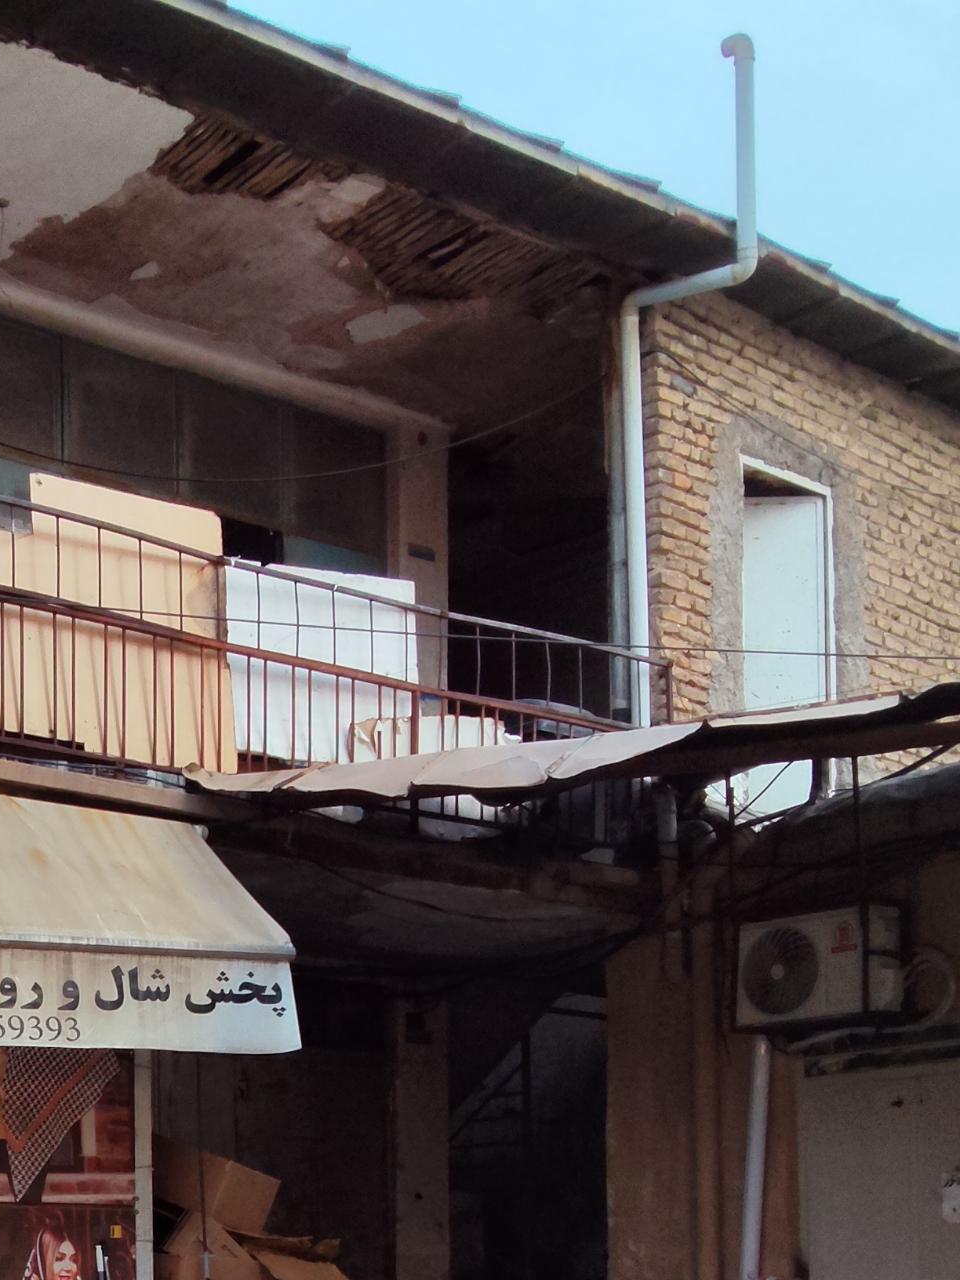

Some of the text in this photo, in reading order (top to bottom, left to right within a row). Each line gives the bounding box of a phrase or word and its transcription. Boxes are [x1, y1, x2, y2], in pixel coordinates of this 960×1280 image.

[57, 976, 80, 1010] و
[94, 965, 171, 1011] شال
[184, 970, 288, 1018] پخش
